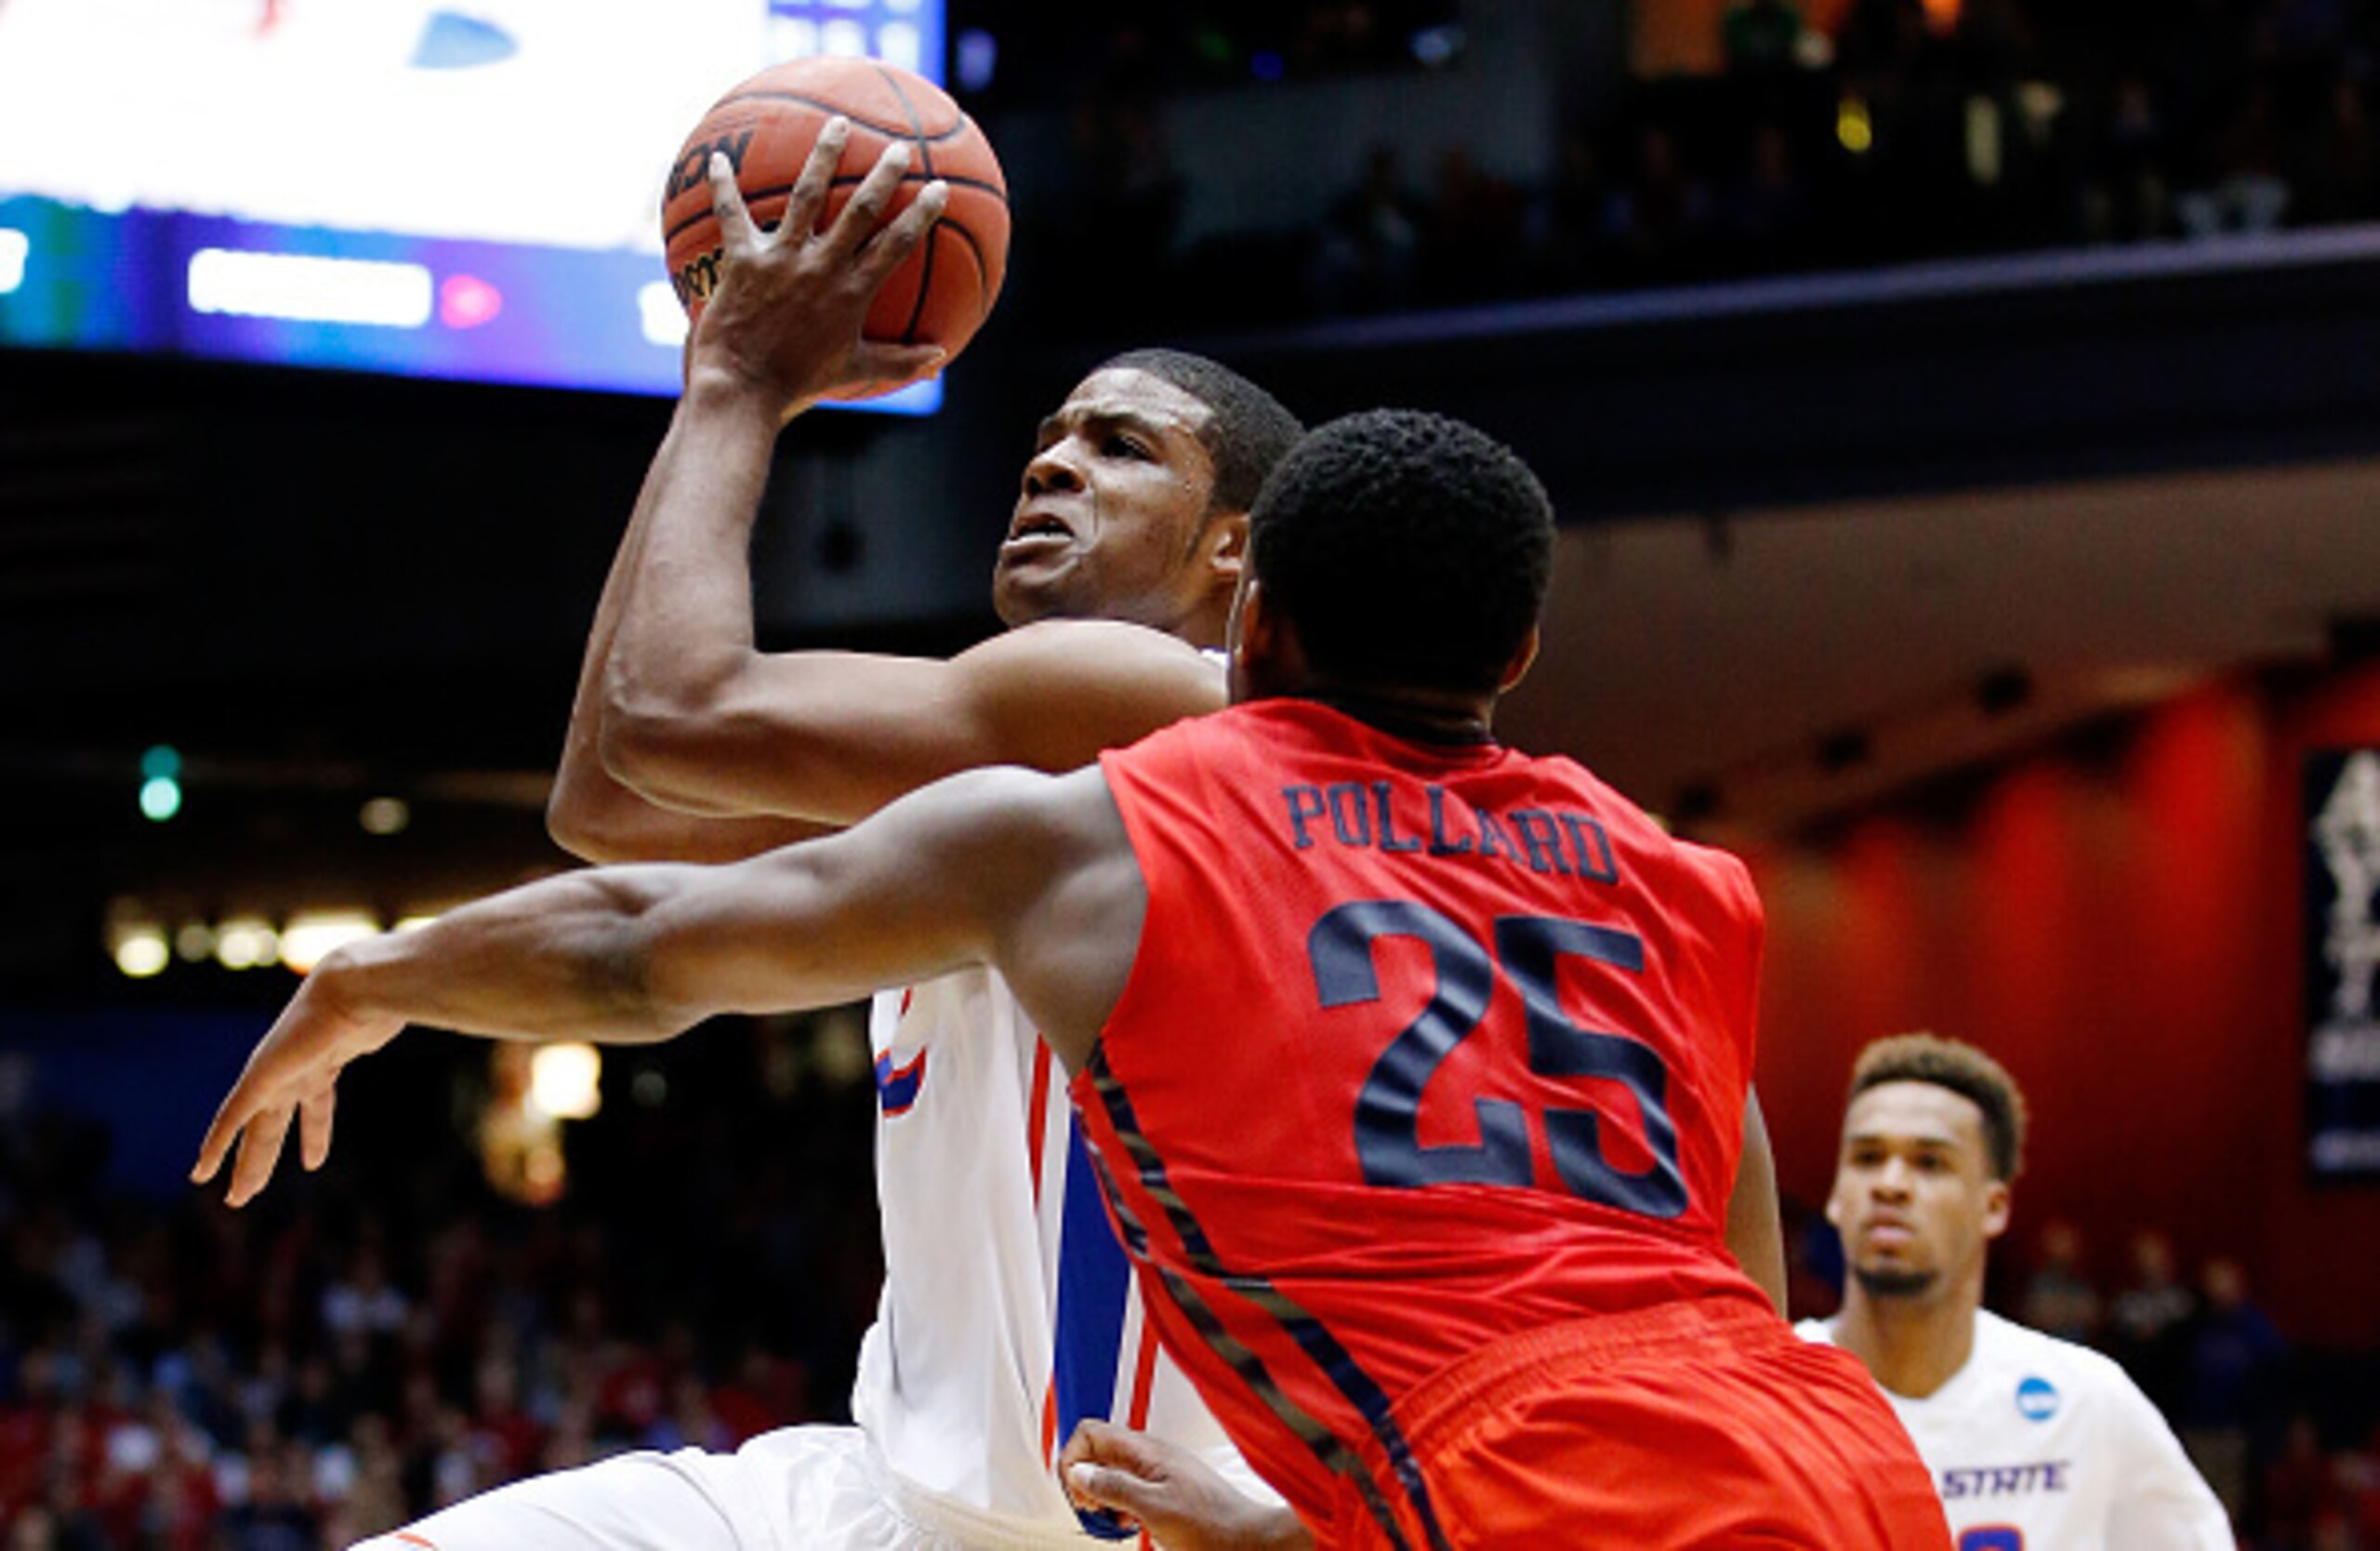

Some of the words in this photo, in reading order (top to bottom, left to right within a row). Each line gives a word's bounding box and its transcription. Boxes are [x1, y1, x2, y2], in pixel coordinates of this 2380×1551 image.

[1282, 781, 1619, 885] POLLARD
[1307, 899, 1689, 1218] 25
[1942, 1460, 2071, 1500] STATE
